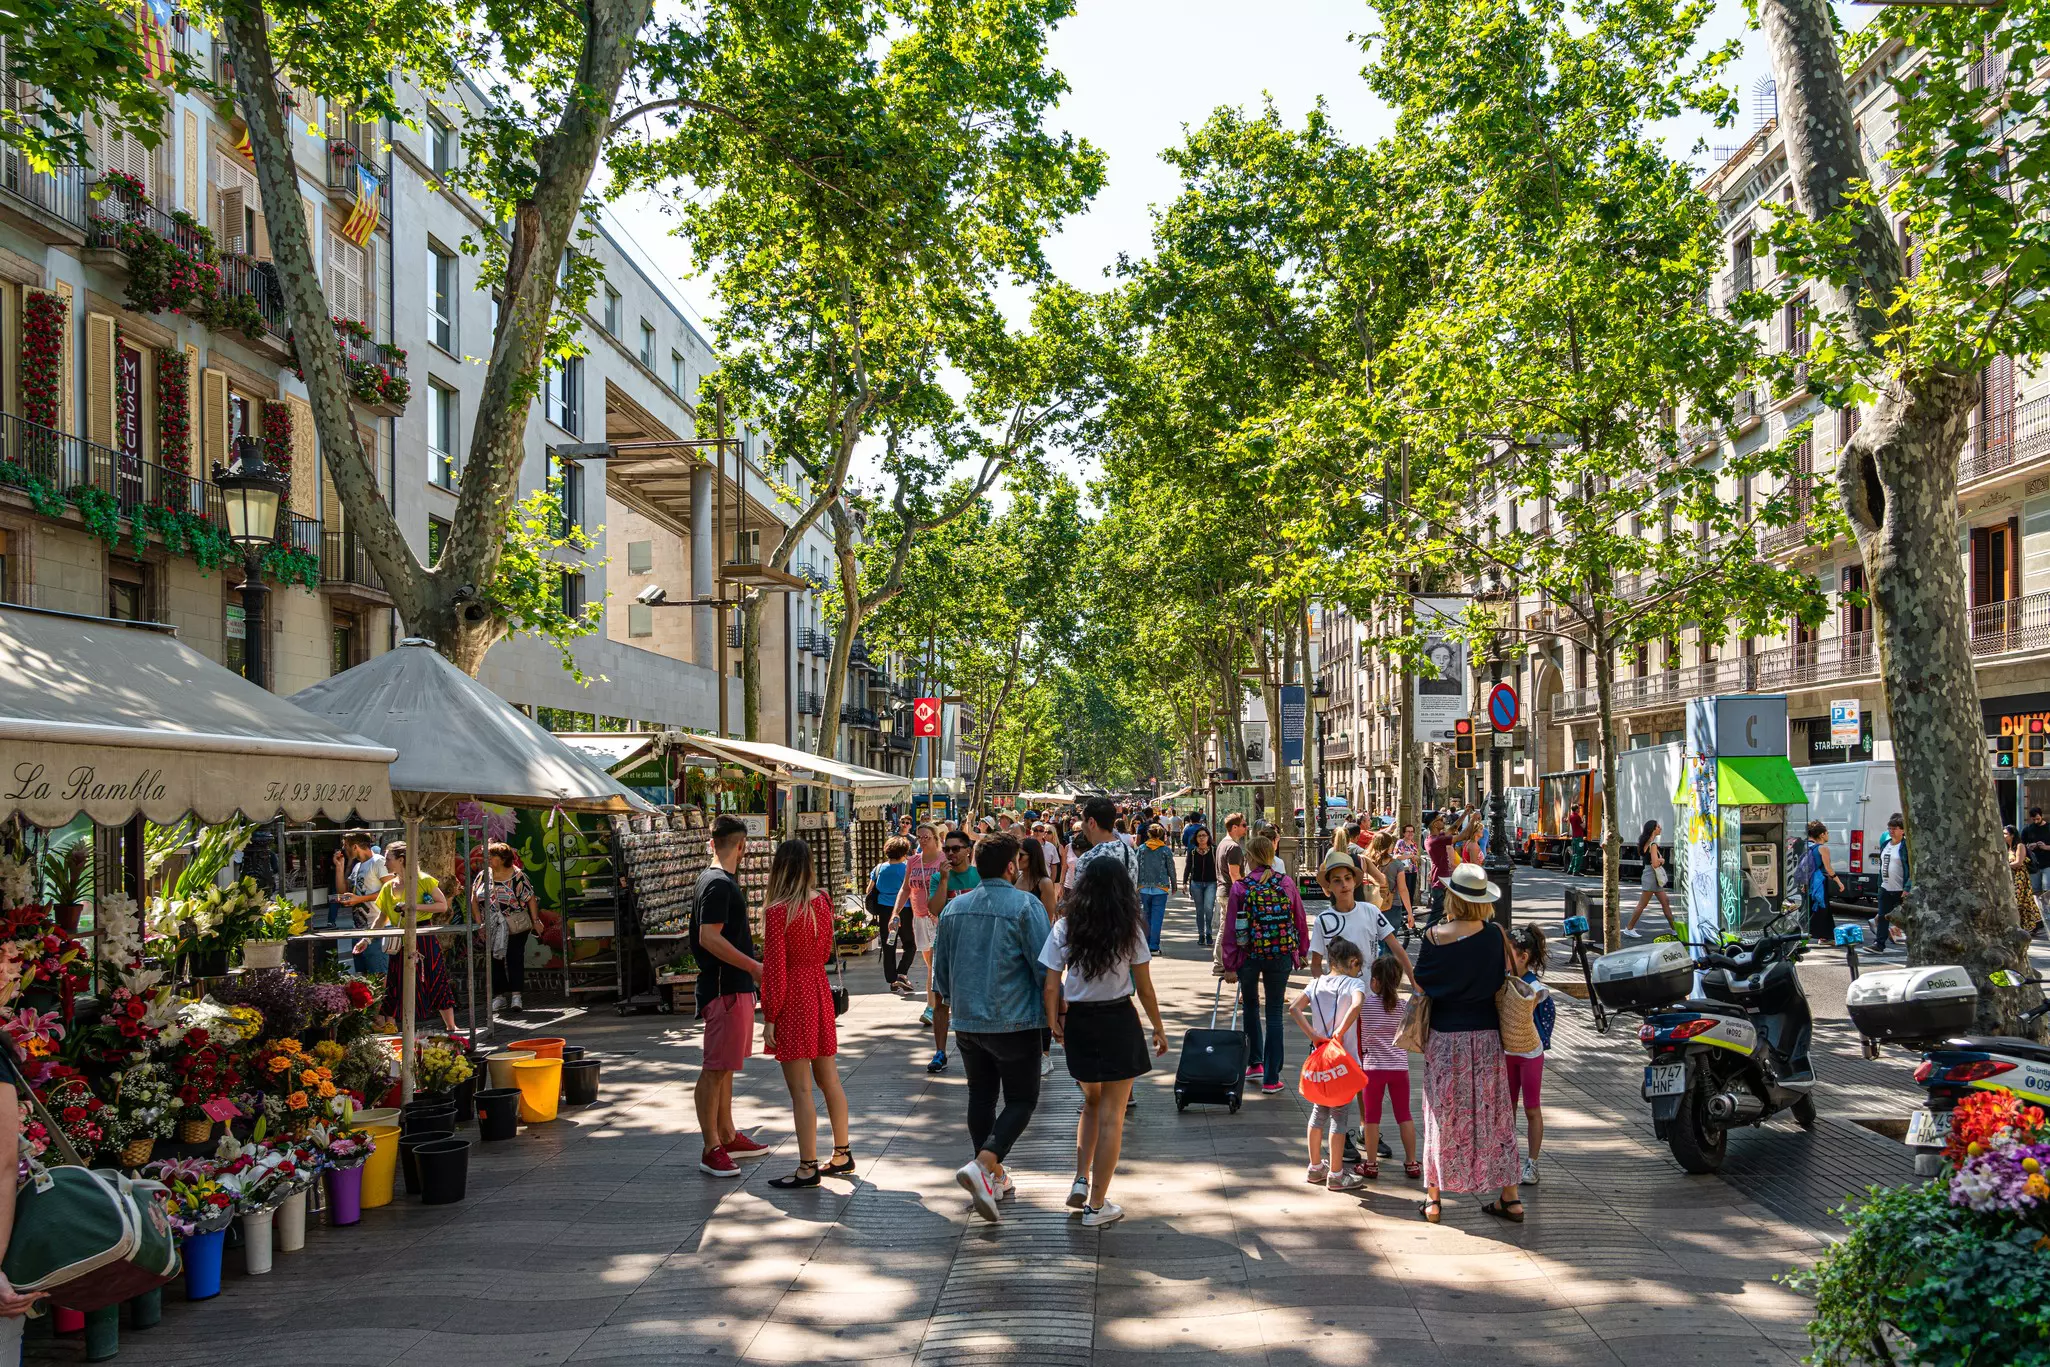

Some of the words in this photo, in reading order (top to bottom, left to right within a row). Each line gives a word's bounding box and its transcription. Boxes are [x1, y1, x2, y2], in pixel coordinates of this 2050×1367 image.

[124, 357, 138, 469] MUSEUM
[919, 708, 928, 717] M
[1834, 708, 1843, 719] P
[4, 762, 51, 800] La
[61, 766, 168, 801] Rambla
[263, 782, 288, 802] Tel.
[290, 783, 311, 802] 93
[312, 783, 337, 802] 302
[337, 784, 355, 802] 50
[355, 784, 373, 802] 22
[1662, 951, 1683, 962] Policia
[1926, 978, 1957, 990] Policia
[1653, 1065, 1682, 1080] 1747
[1653, 1079, 1675, 1094] HNF
[1917, 1128, 1942, 1144] HN
